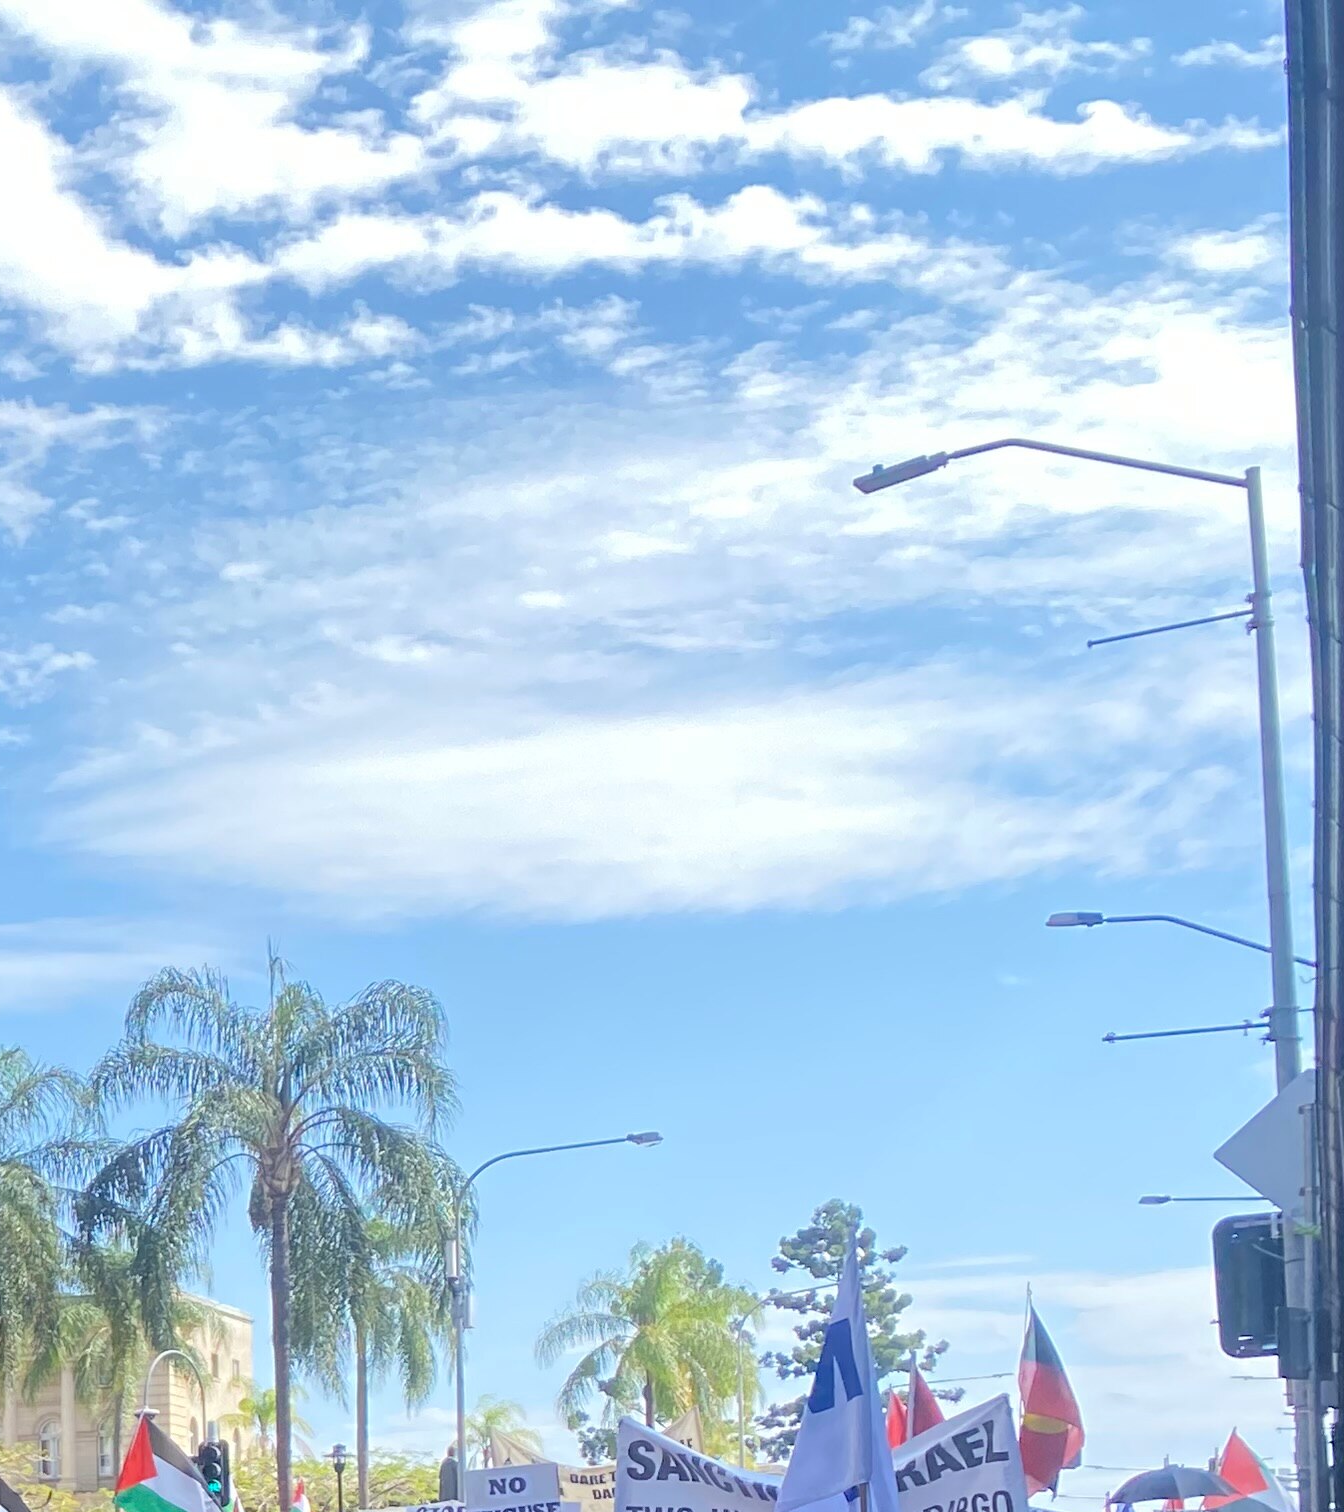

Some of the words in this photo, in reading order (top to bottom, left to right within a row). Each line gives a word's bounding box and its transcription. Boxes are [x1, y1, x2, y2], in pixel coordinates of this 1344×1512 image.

[895, 1419, 1010, 1492] RAEL
[488, 1476, 527, 1497] NO
[570, 1473, 605, 1485] DARE
